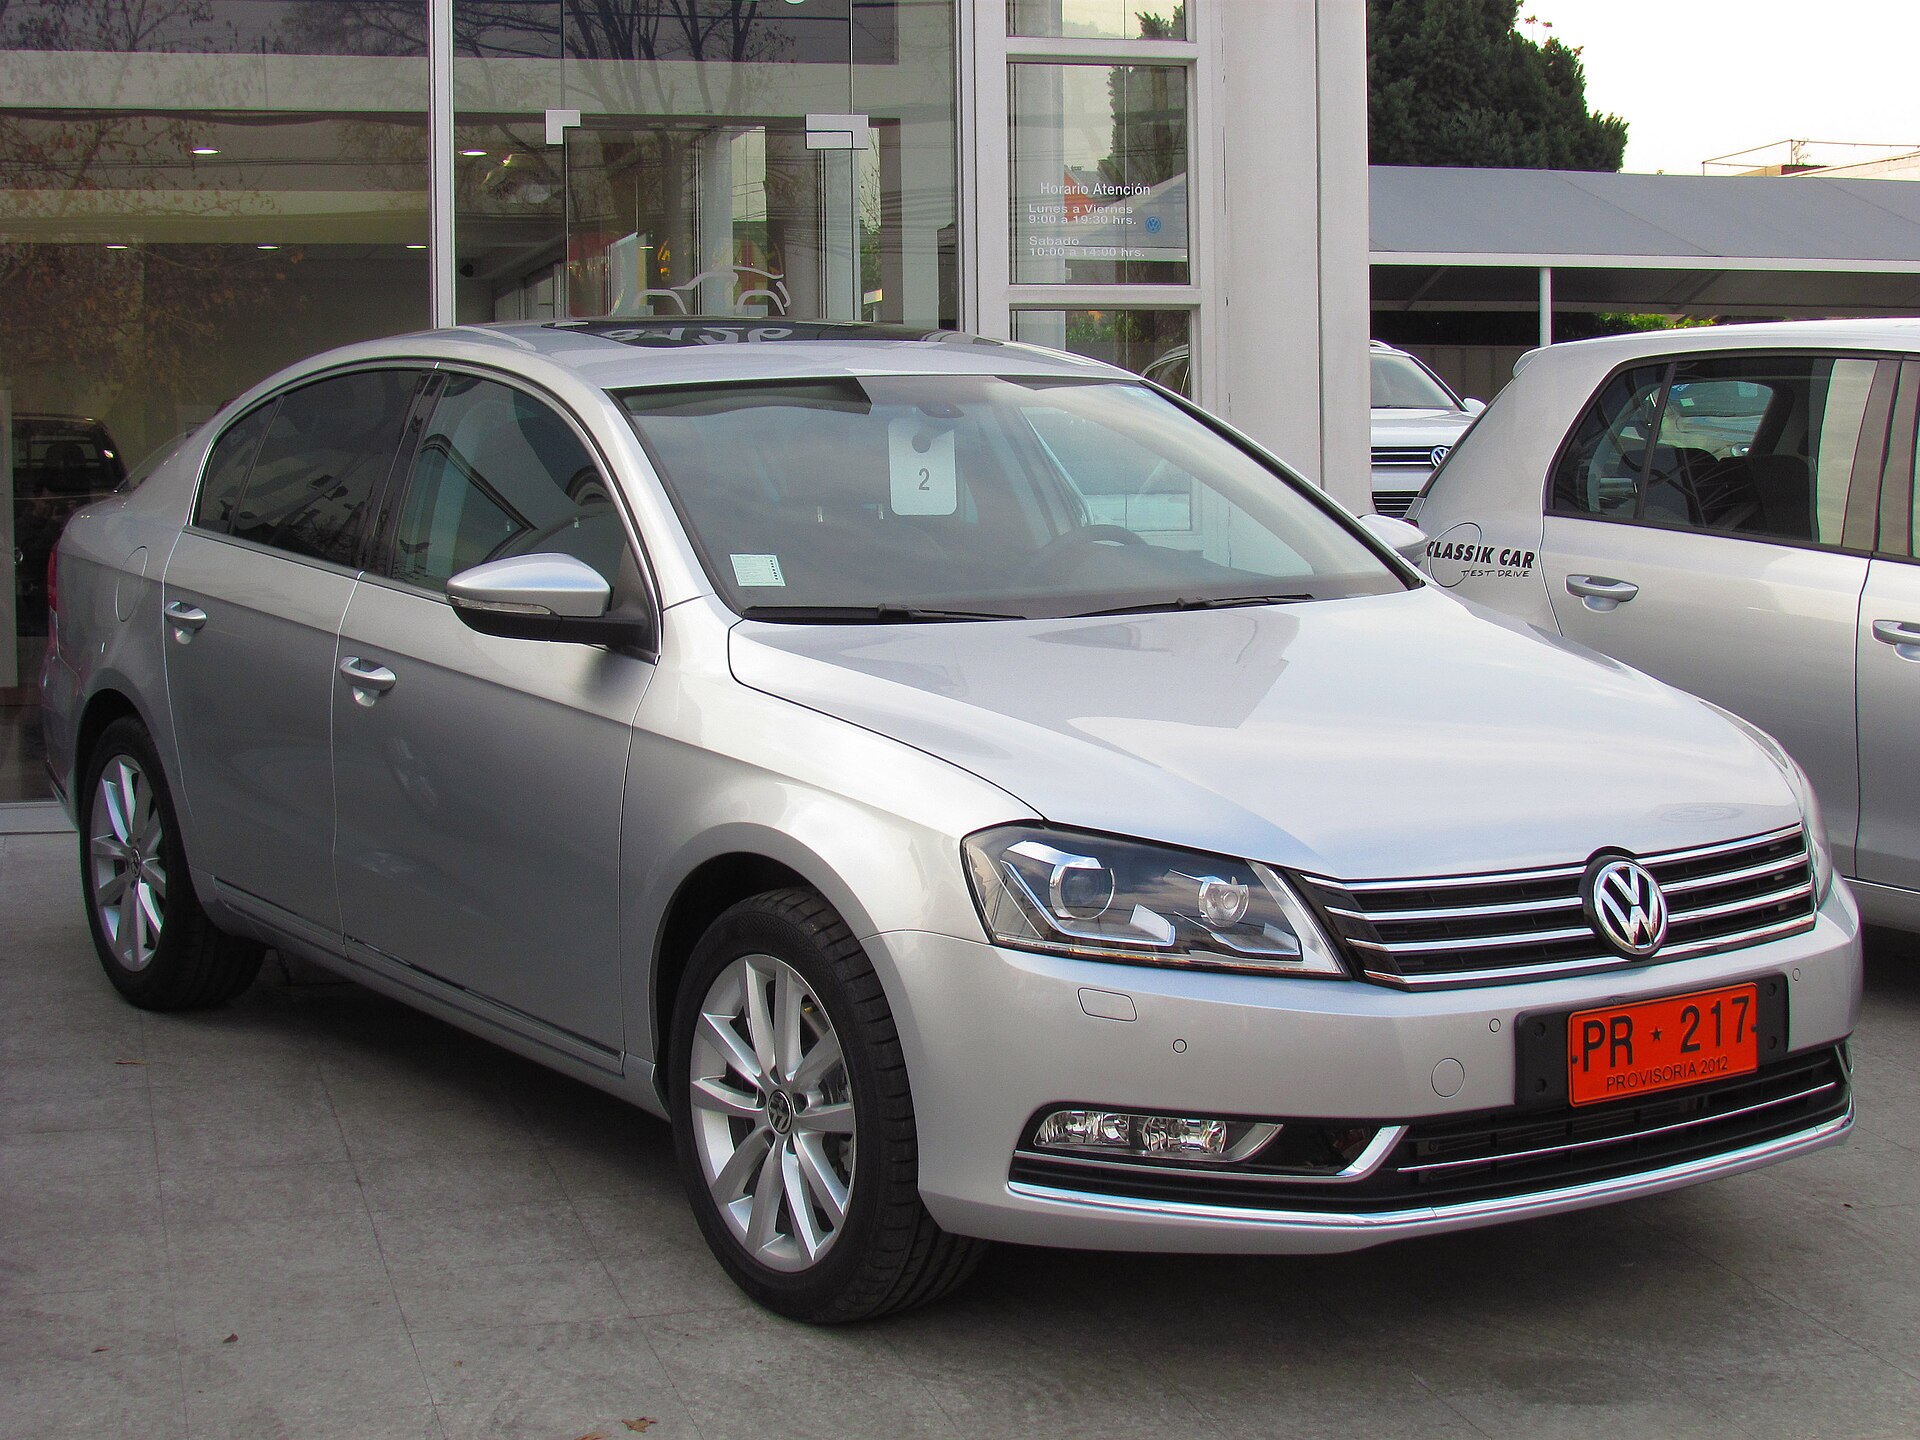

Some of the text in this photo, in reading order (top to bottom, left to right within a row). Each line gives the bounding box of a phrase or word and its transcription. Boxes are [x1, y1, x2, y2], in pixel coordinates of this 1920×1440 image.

[1040, 182, 1151, 195] Horario Atención
[1028, 204, 1134, 214] Lunes a Viernes
[1028, 215, 1137, 225] 9:00 a 19:30 hrs.
[1029, 236, 1080, 246] Sabado
[1030, 247, 1065, 257] 10:00
[1082, 247, 1117, 257] 14:00
[1120, 247, 1145, 257] hrs.
[918, 467, 931, 491] 2
[1426, 541, 1535, 568] CLASSIK CAR
[1461, 569, 1530, 577] TEST DRIVE
[1598, 865, 1660, 949] VW
[1582, 995, 1750, 1073] PR 217
[1606, 1055, 1728, 1092] PROVISORIA 2012
